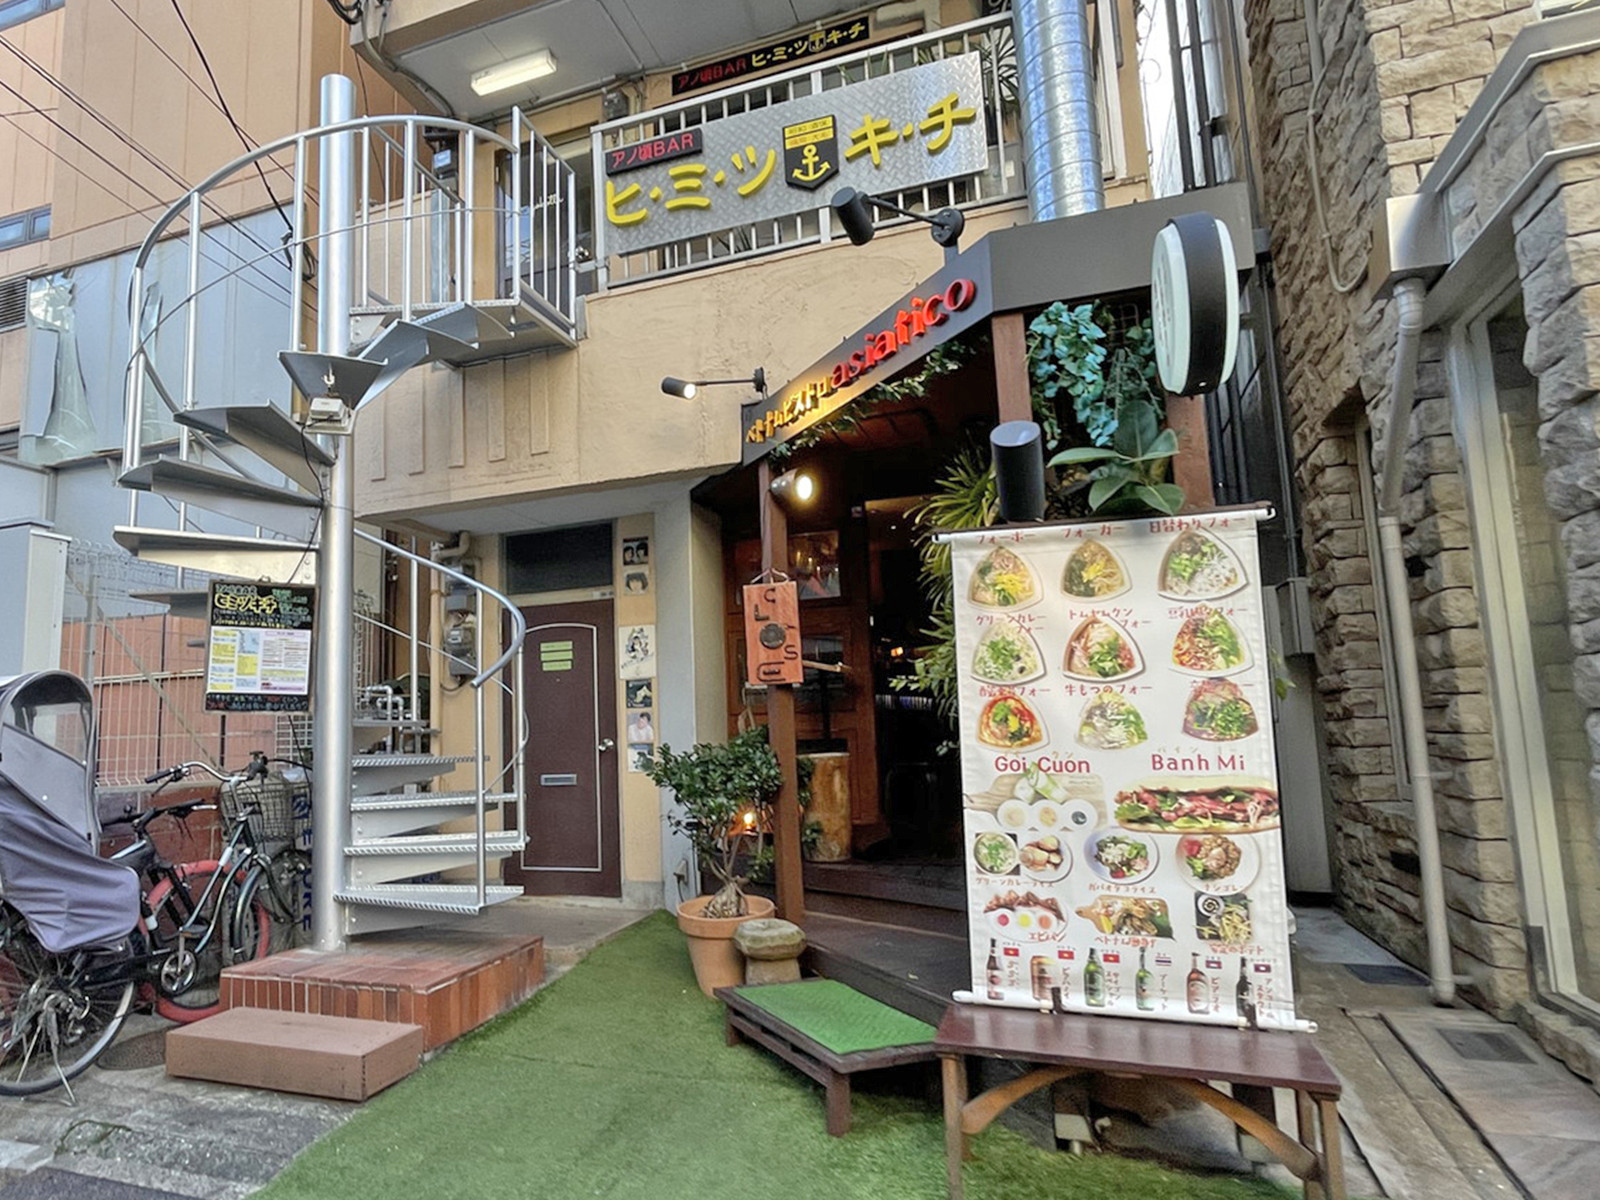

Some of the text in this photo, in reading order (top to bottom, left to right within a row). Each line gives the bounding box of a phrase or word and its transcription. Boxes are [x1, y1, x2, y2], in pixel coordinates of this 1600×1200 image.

[994, 755, 1090, 774] Goi Cuon
[1151, 753, 1246, 771] Banh Mi
